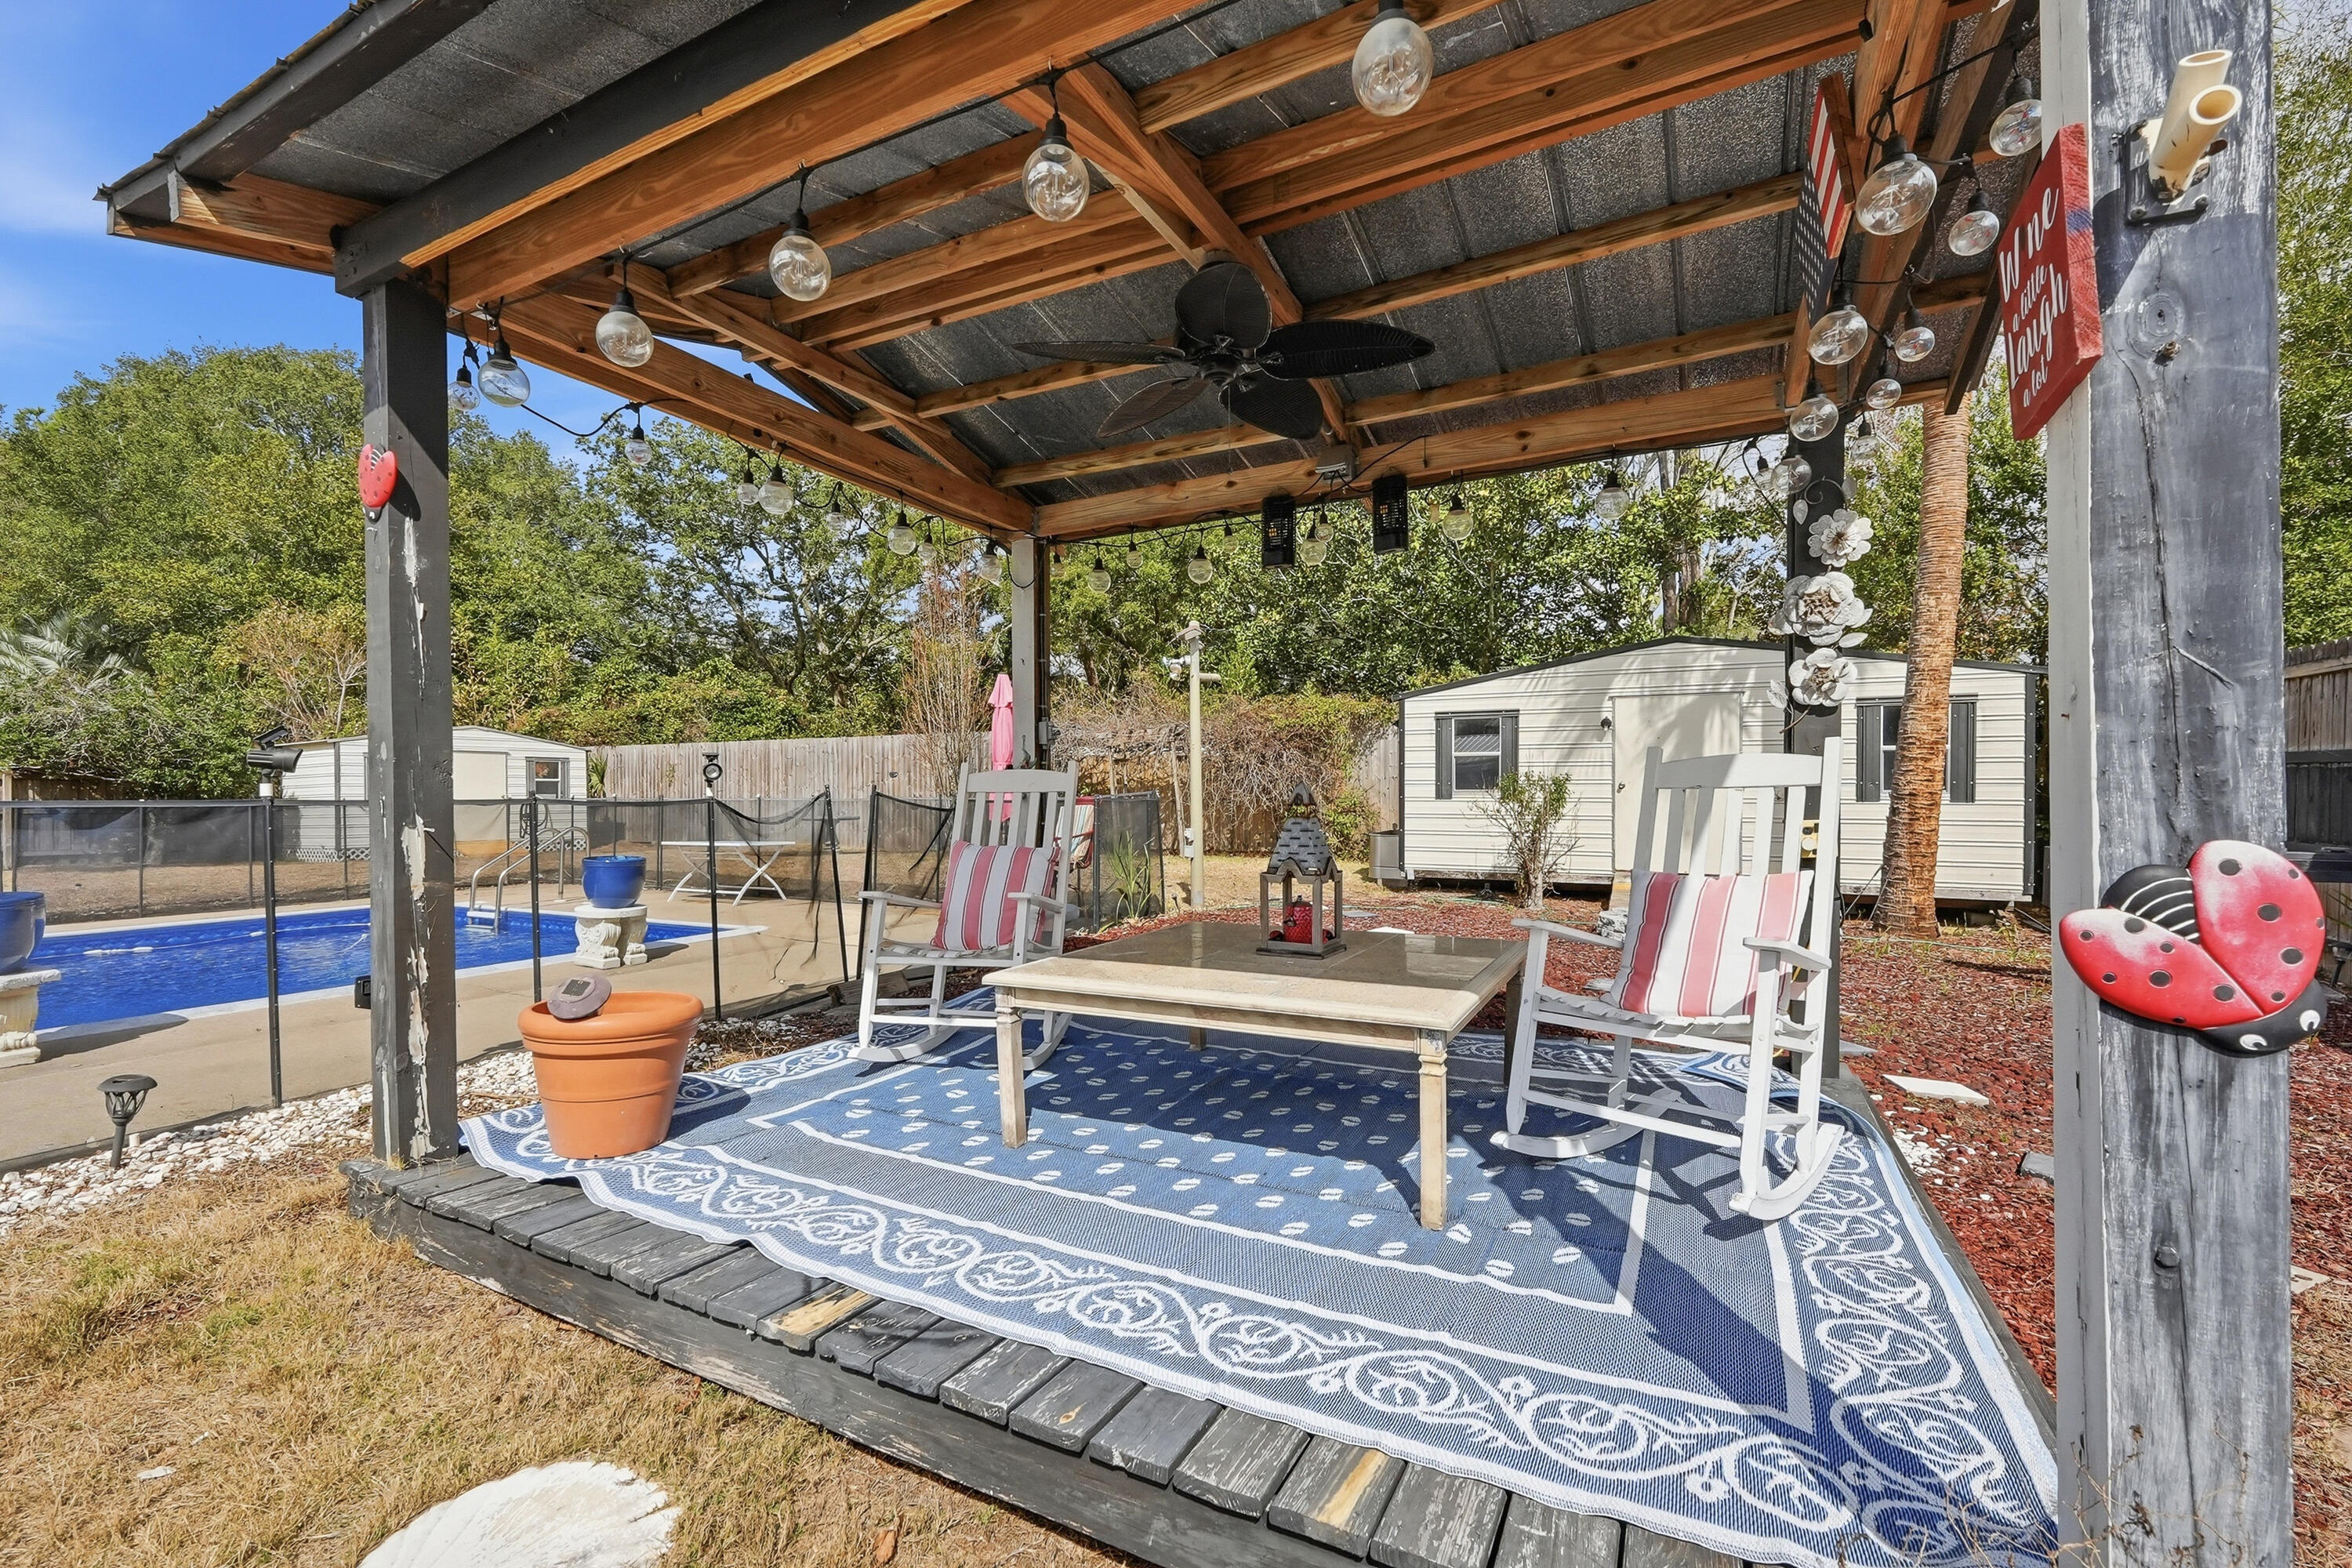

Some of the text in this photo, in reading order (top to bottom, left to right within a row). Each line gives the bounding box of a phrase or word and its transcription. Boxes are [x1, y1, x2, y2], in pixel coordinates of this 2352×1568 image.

[2013, 265, 2047, 332] a little
[2024, 354, 2048, 407] a lot
